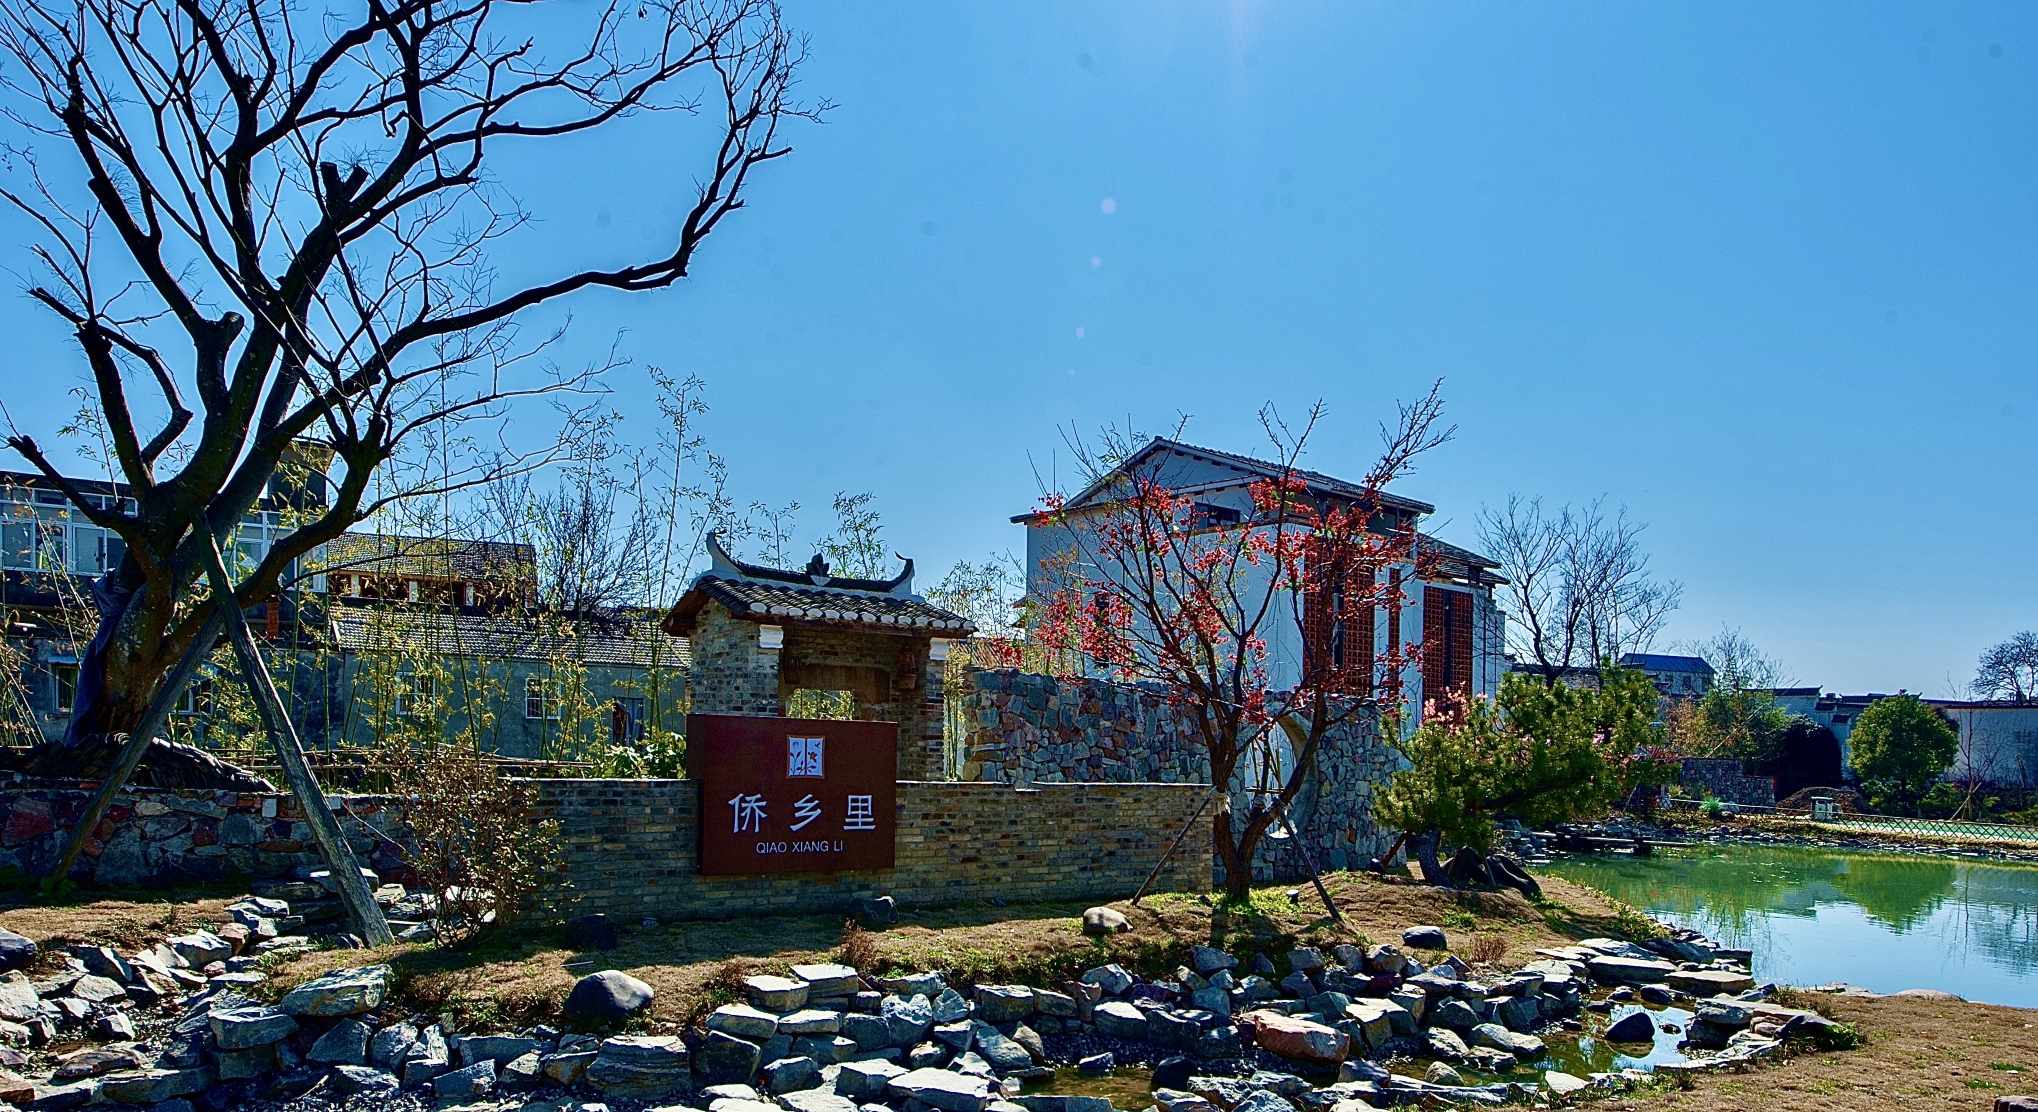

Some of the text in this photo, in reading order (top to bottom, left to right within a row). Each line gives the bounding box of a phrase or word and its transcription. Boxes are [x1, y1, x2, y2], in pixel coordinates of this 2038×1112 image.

[728, 793, 876, 834] 侨乡里
[756, 840, 844, 854] QIAO XIANG LI
